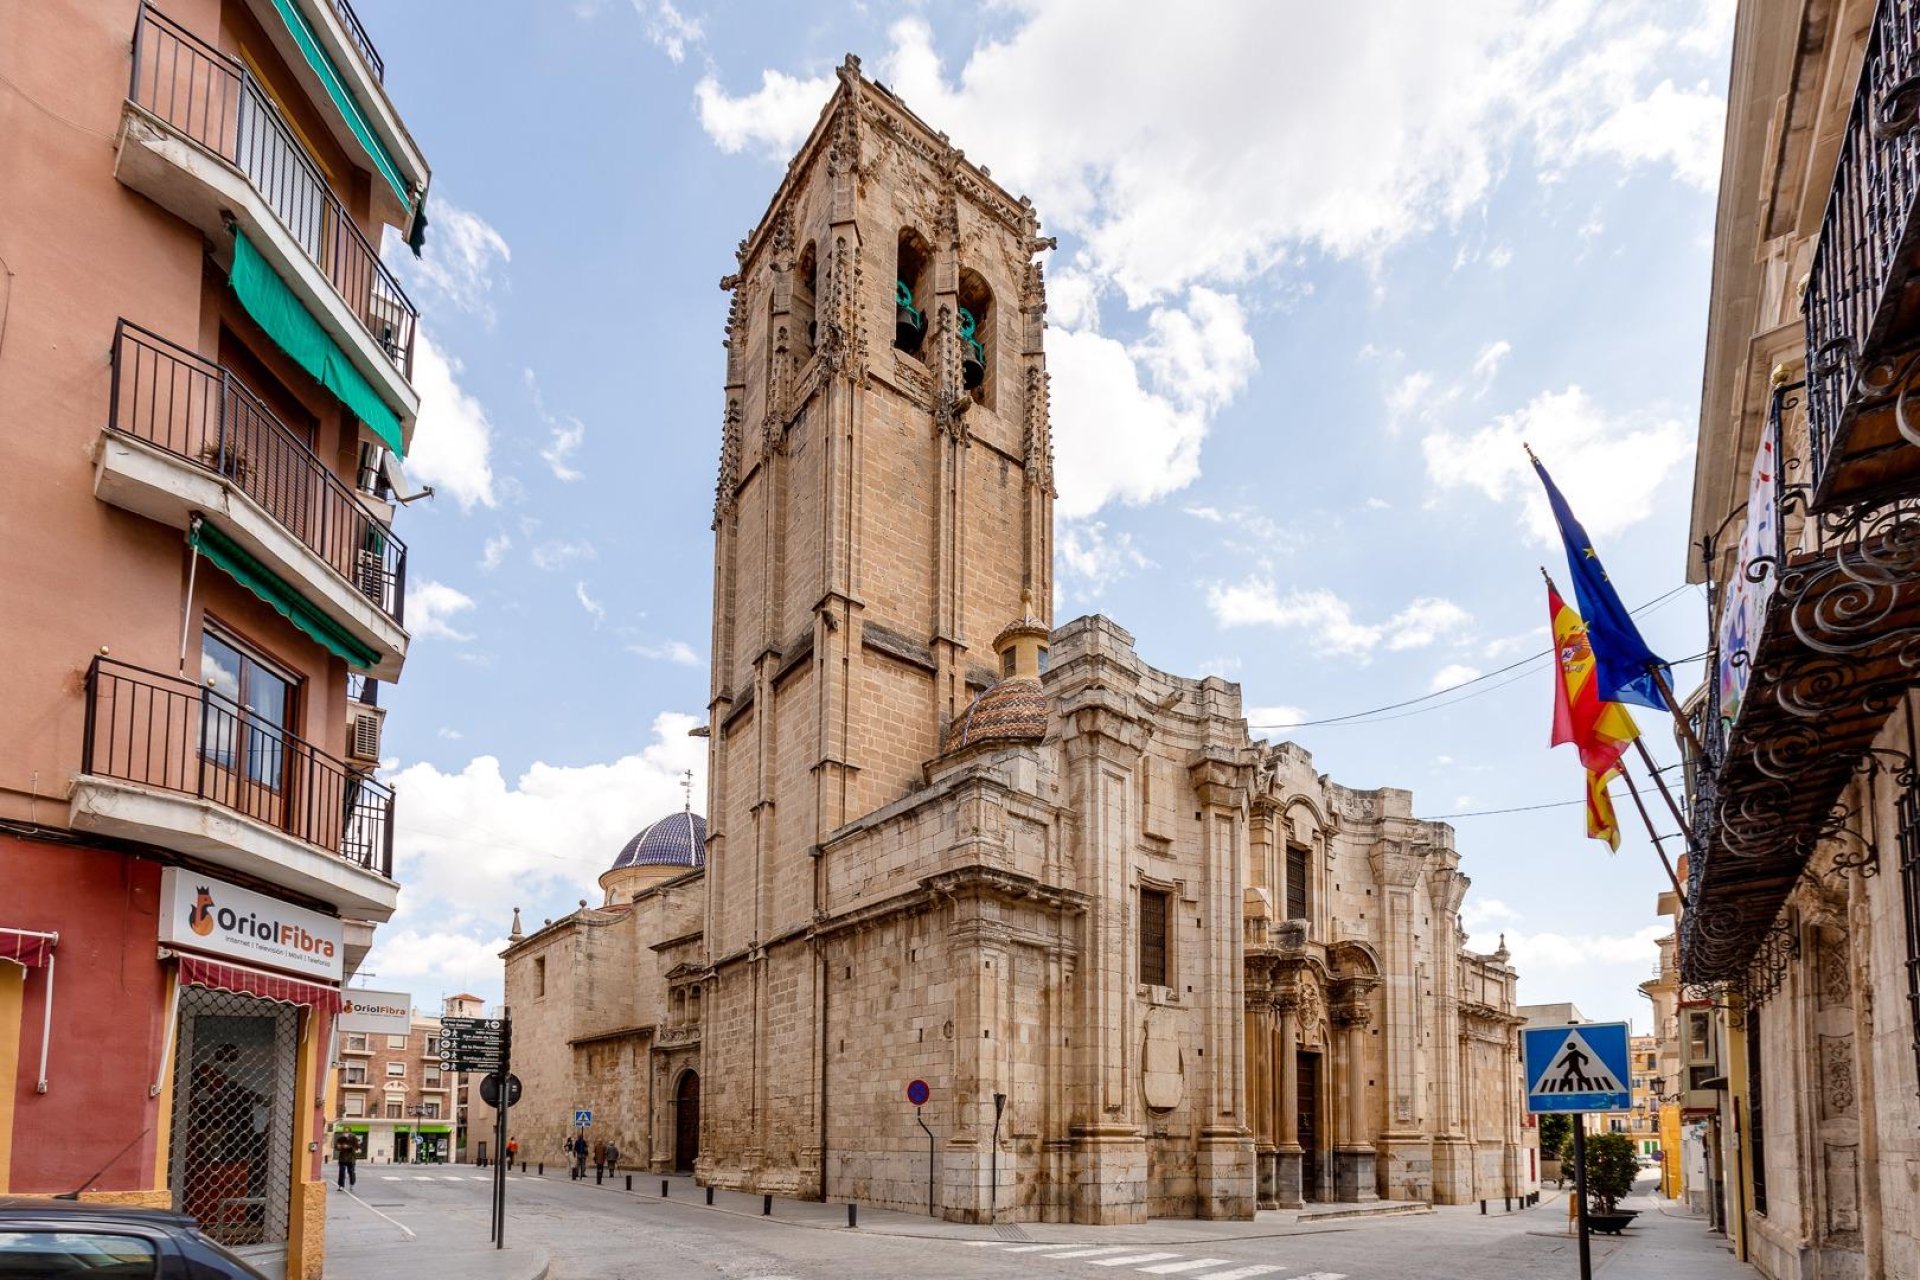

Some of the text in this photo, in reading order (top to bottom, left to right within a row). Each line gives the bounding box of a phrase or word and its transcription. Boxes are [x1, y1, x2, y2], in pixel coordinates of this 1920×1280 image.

[217, 907, 335, 958] OriolFibra
[225, 936, 250, 948] Internet
[354, 1004, 406, 1015] OriolFibra
